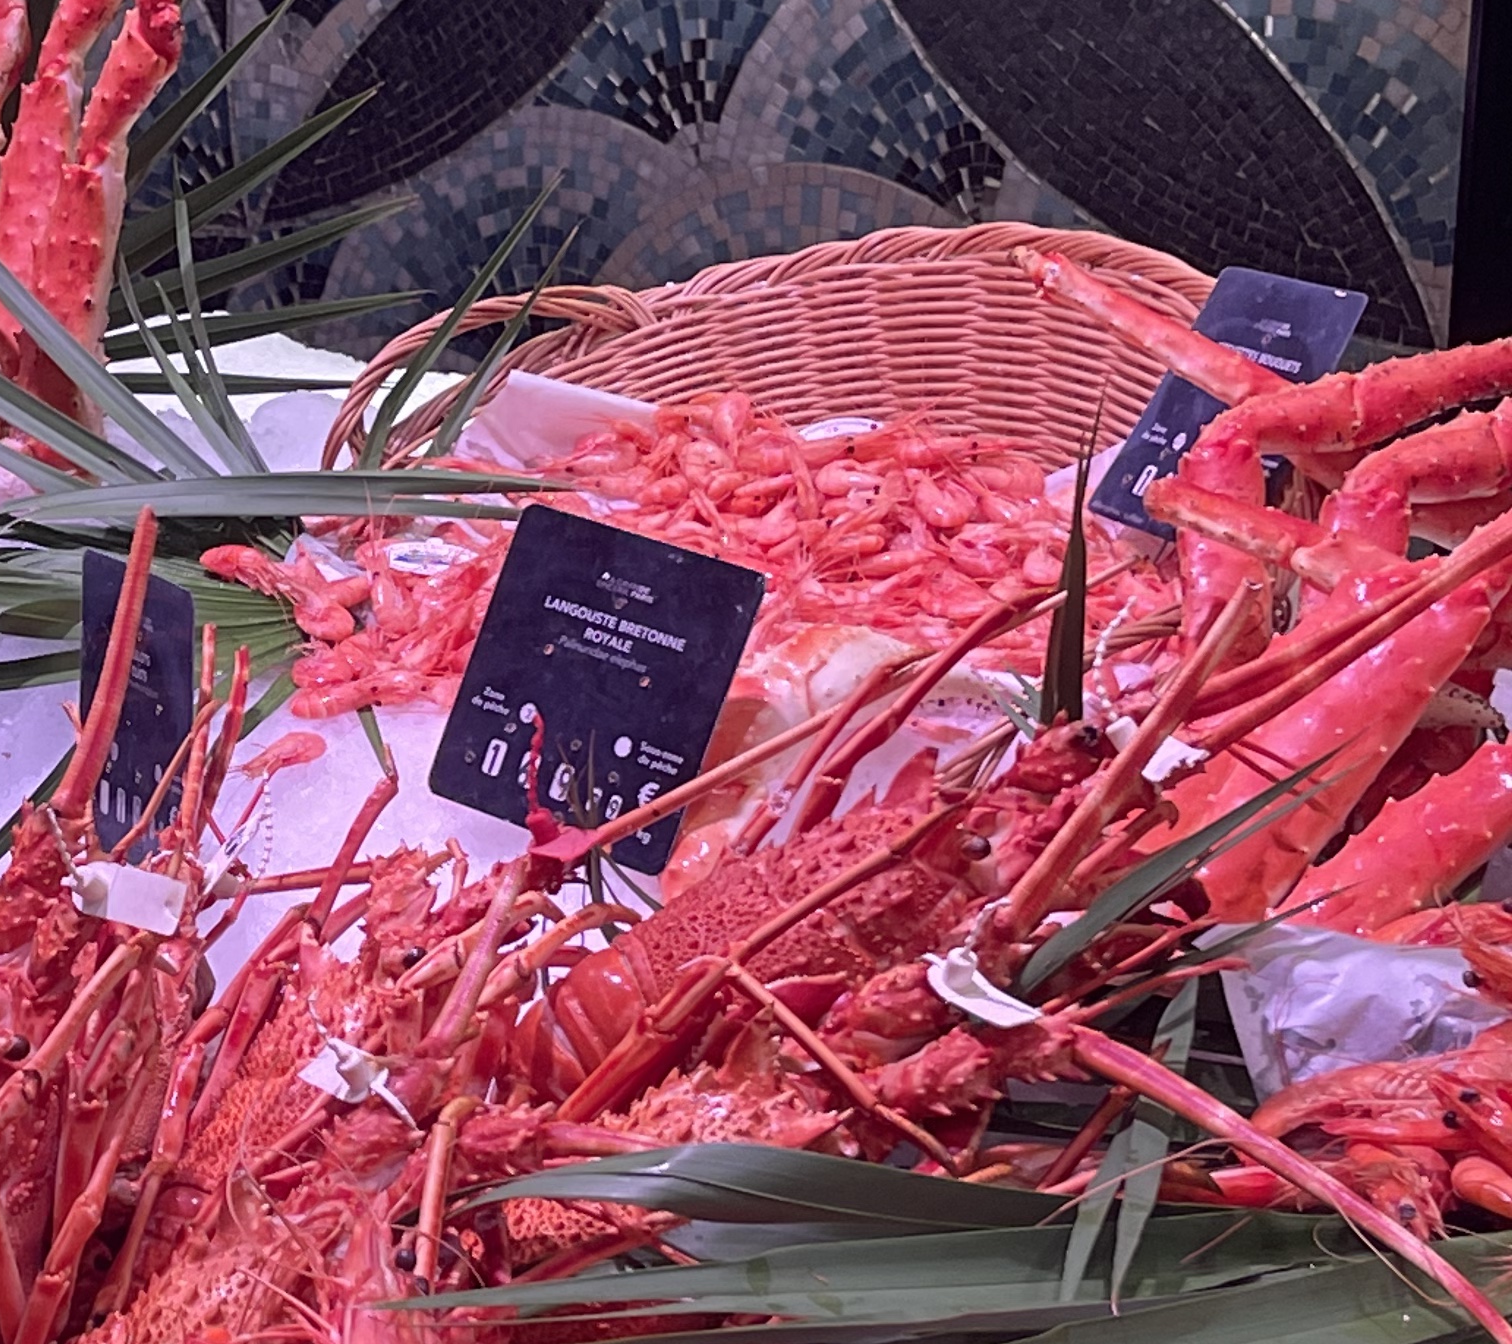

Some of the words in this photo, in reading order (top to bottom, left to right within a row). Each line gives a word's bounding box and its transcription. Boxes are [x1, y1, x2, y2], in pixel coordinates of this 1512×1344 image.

[543, 595, 619, 632] LANGOUSTE
[618, 618, 688, 653] BRETONNE
[583, 628, 634, 654] ROYALE
